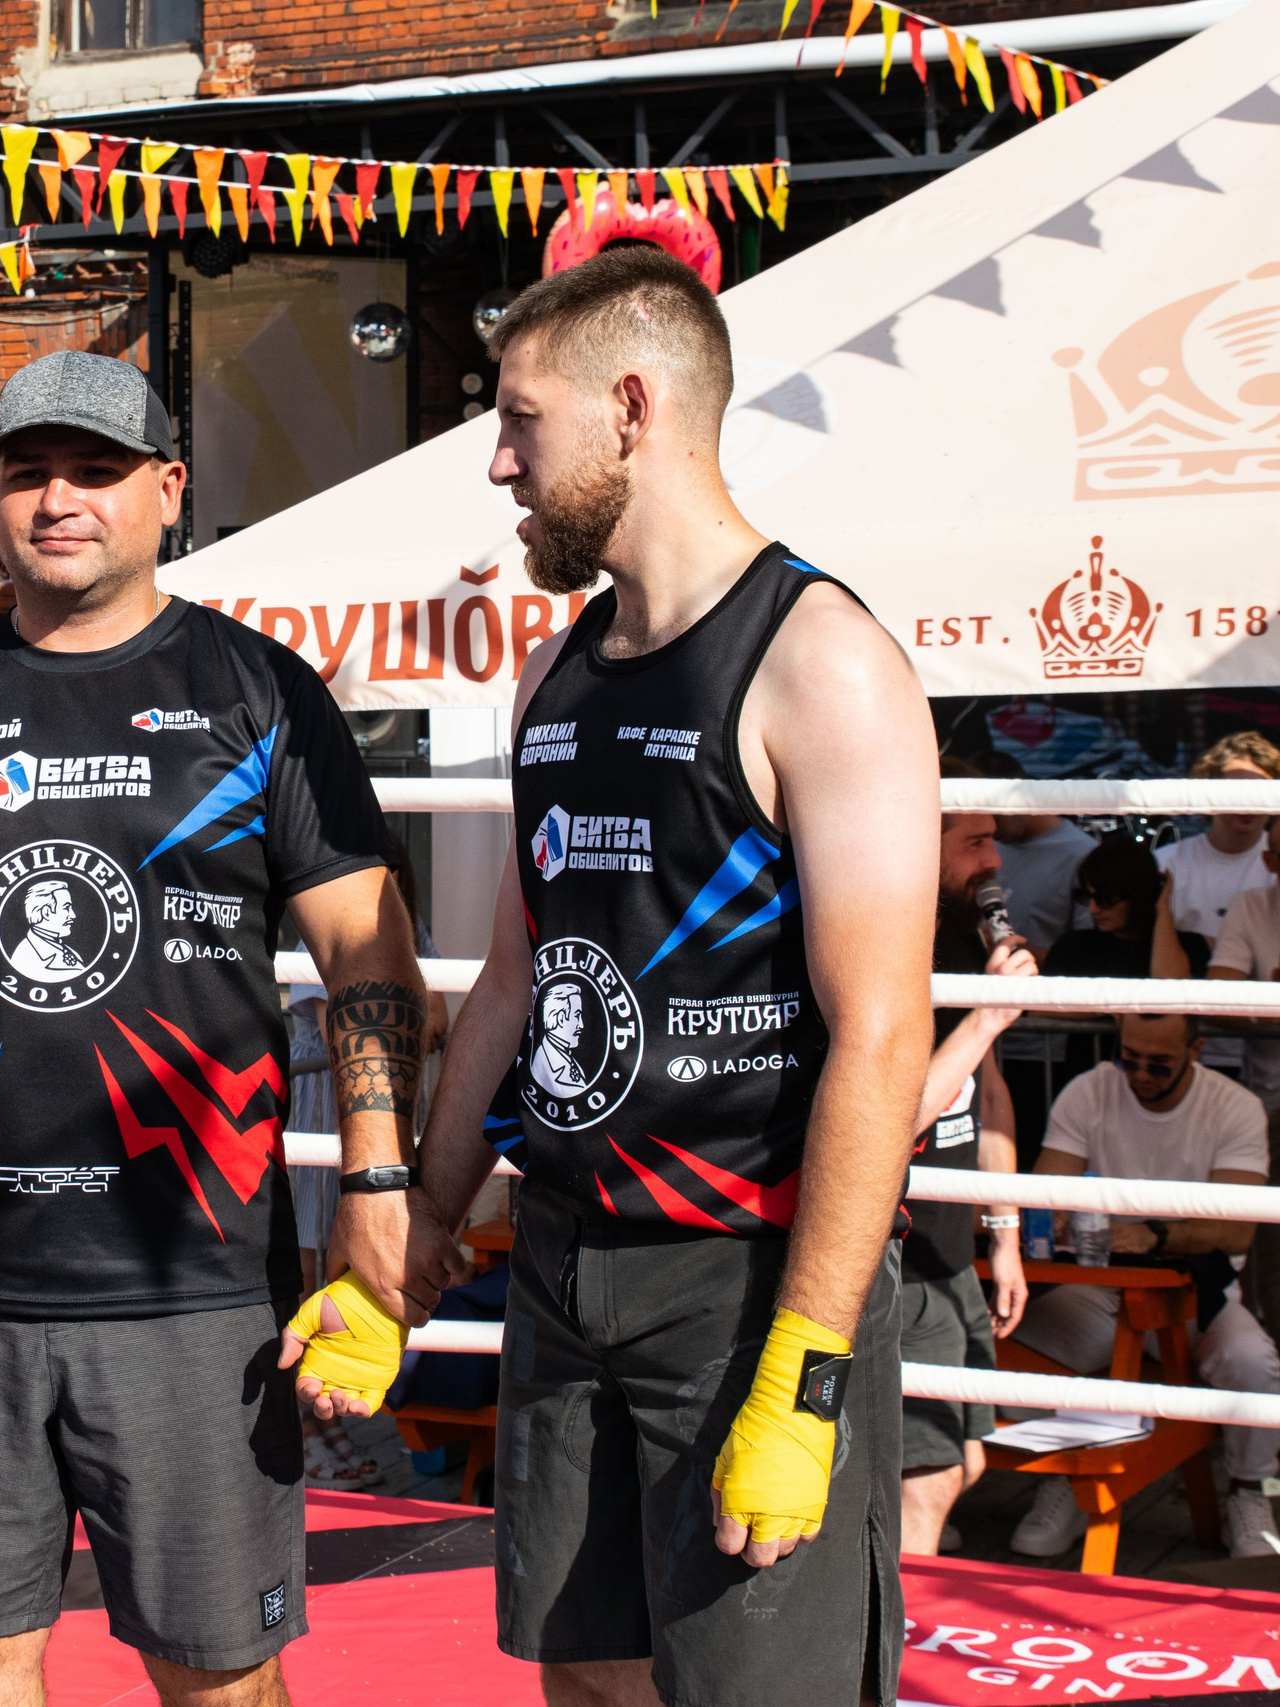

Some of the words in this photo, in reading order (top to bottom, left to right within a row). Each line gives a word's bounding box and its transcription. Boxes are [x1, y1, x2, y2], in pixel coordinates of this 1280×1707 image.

[915, 616, 1010, 647] EST.
[1185, 606, 1280, 638] 158
[523, 721, 577, 746] МИХАИЛ
[617, 726, 648, 741] КАФЕ
[650, 727, 701, 745] КАРАОКЕ
[520, 742, 578, 767] ВОРОНИН
[643, 743, 696, 762] ПЯТНИЦА
[38, 755, 151, 783] БИТВА
[37, 781, 151, 800] ОБЩЕПИТОВ
[571, 815, 652, 852] БИТВА
[568, 852, 654, 873] ОБЩЕПИТОВ
[196, 945, 243, 961] LADO
[0, 971, 105, 1002] 2010
[529, 945, 636, 1050] НЦЛЕРЪ
[669, 997, 703, 1007] ПЕРВАЯ
[706, 995, 744, 1007] РУССКАЯ
[746, 991, 799, 1003] ВИНОКУРНЯ
[667, 1000, 800, 1035] КРУТОЯР
[713, 1053, 799, 1075] LADOGA
[524, 1084, 606, 1121] 2010
[822, 1380, 830, 1401] FLEX
[826, 1375, 836, 1406] POWER
[967, 1667, 1125, 1698] GIN
